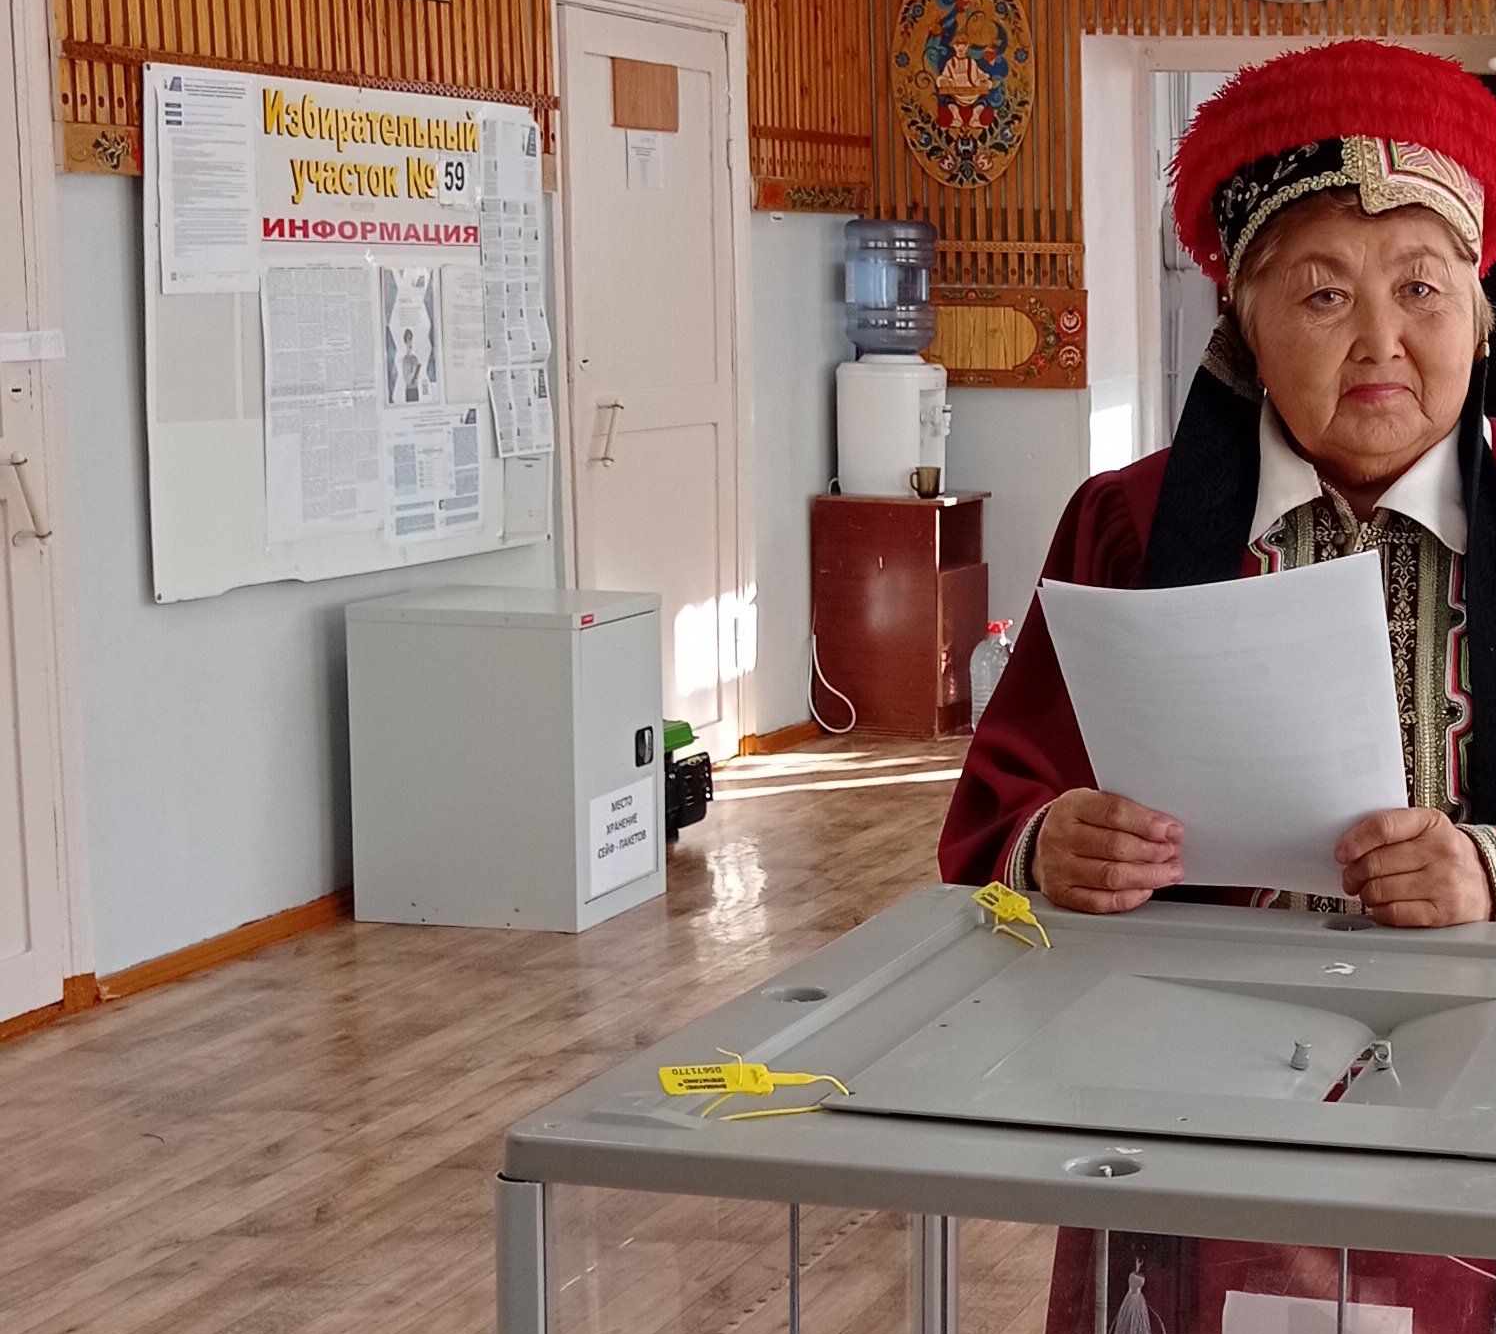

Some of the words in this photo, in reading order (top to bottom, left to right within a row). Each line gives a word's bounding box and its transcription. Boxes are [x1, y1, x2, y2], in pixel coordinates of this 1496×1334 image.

[262, 87, 479, 153] Избирательный
[291, 154, 398, 204] участок
[444, 161, 466, 192] 59
[262, 217, 479, 244] ИНФОРМАЦИЯ
[611, 795, 633, 812] МЕСТО
[606, 812, 637, 835] ХРАНЕНИЕ
[598, 843, 614, 859] СЕЙФ
[619, 829, 646, 850] ПАКЕТОВ
[671, 1066, 721, 1074] D5671770
